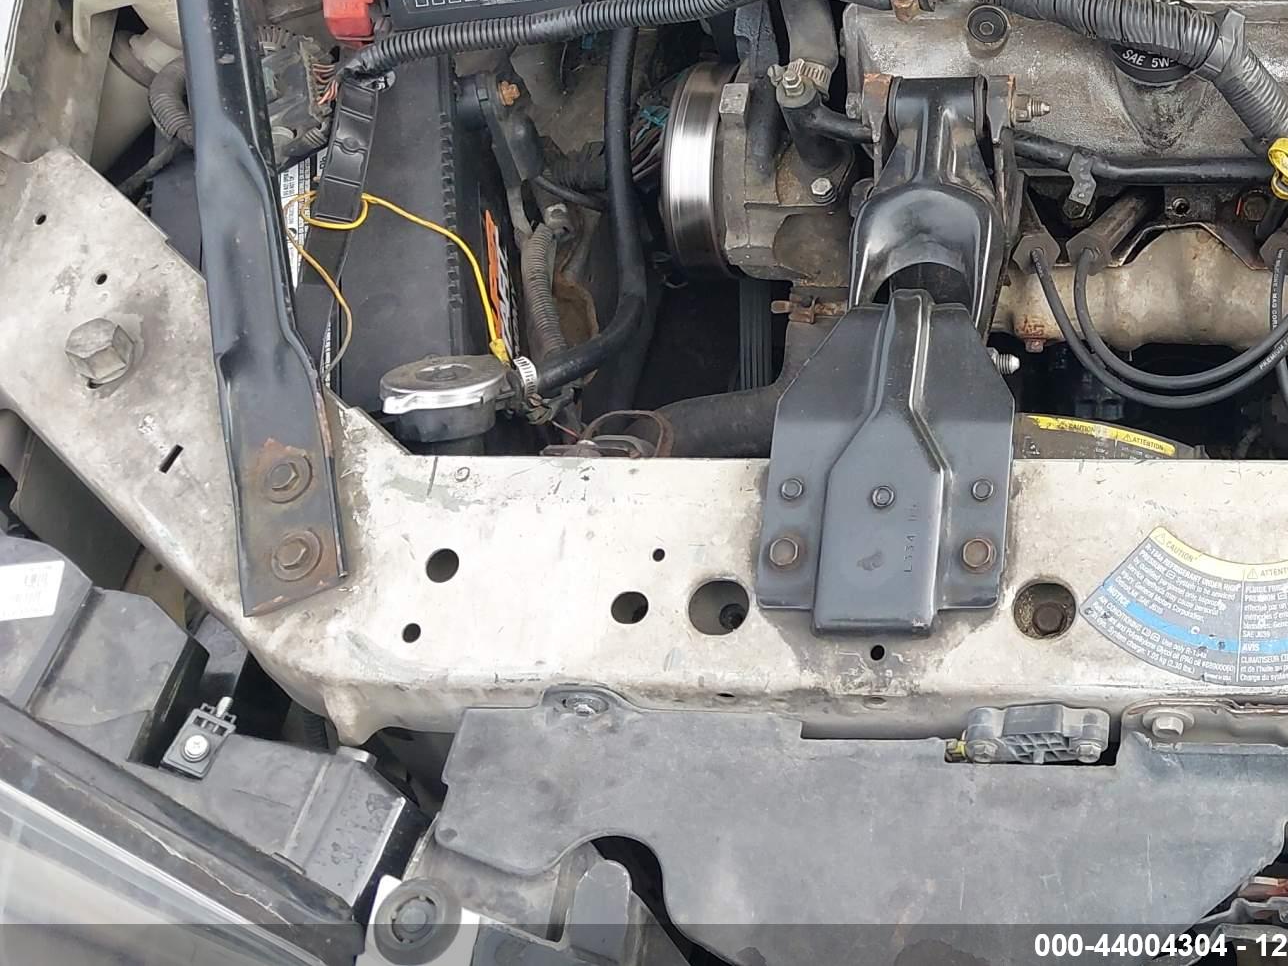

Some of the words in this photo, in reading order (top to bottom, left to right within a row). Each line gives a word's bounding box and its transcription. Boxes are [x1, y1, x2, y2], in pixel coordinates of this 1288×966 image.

[1122, 49, 1146, 66] SAE
[1151, 57, 1175, 69] 5W-
[1259, 344, 1285, 370] PREMIUM
[1132, 435, 1165, 451] ATTENTION
[1164, 540, 1194, 562] CAUTION
[1162, 557, 1202, 582] REFRIGERANT
[1200, 577, 1223, 590] UNDER
[1106, 584, 1131, 607] NOTICE
[1134, 581, 1154, 598] General
[1153, 594, 1172, 608] Motors
[1202, 587, 1210, 595] be
[1105, 601, 1142, 631] CONDITIONING
[1107, 625, 1127, 643] System
[1242, 642, 1259, 650] AVIS
[1241, 655, 1279, 663] CLIMATISEUR
